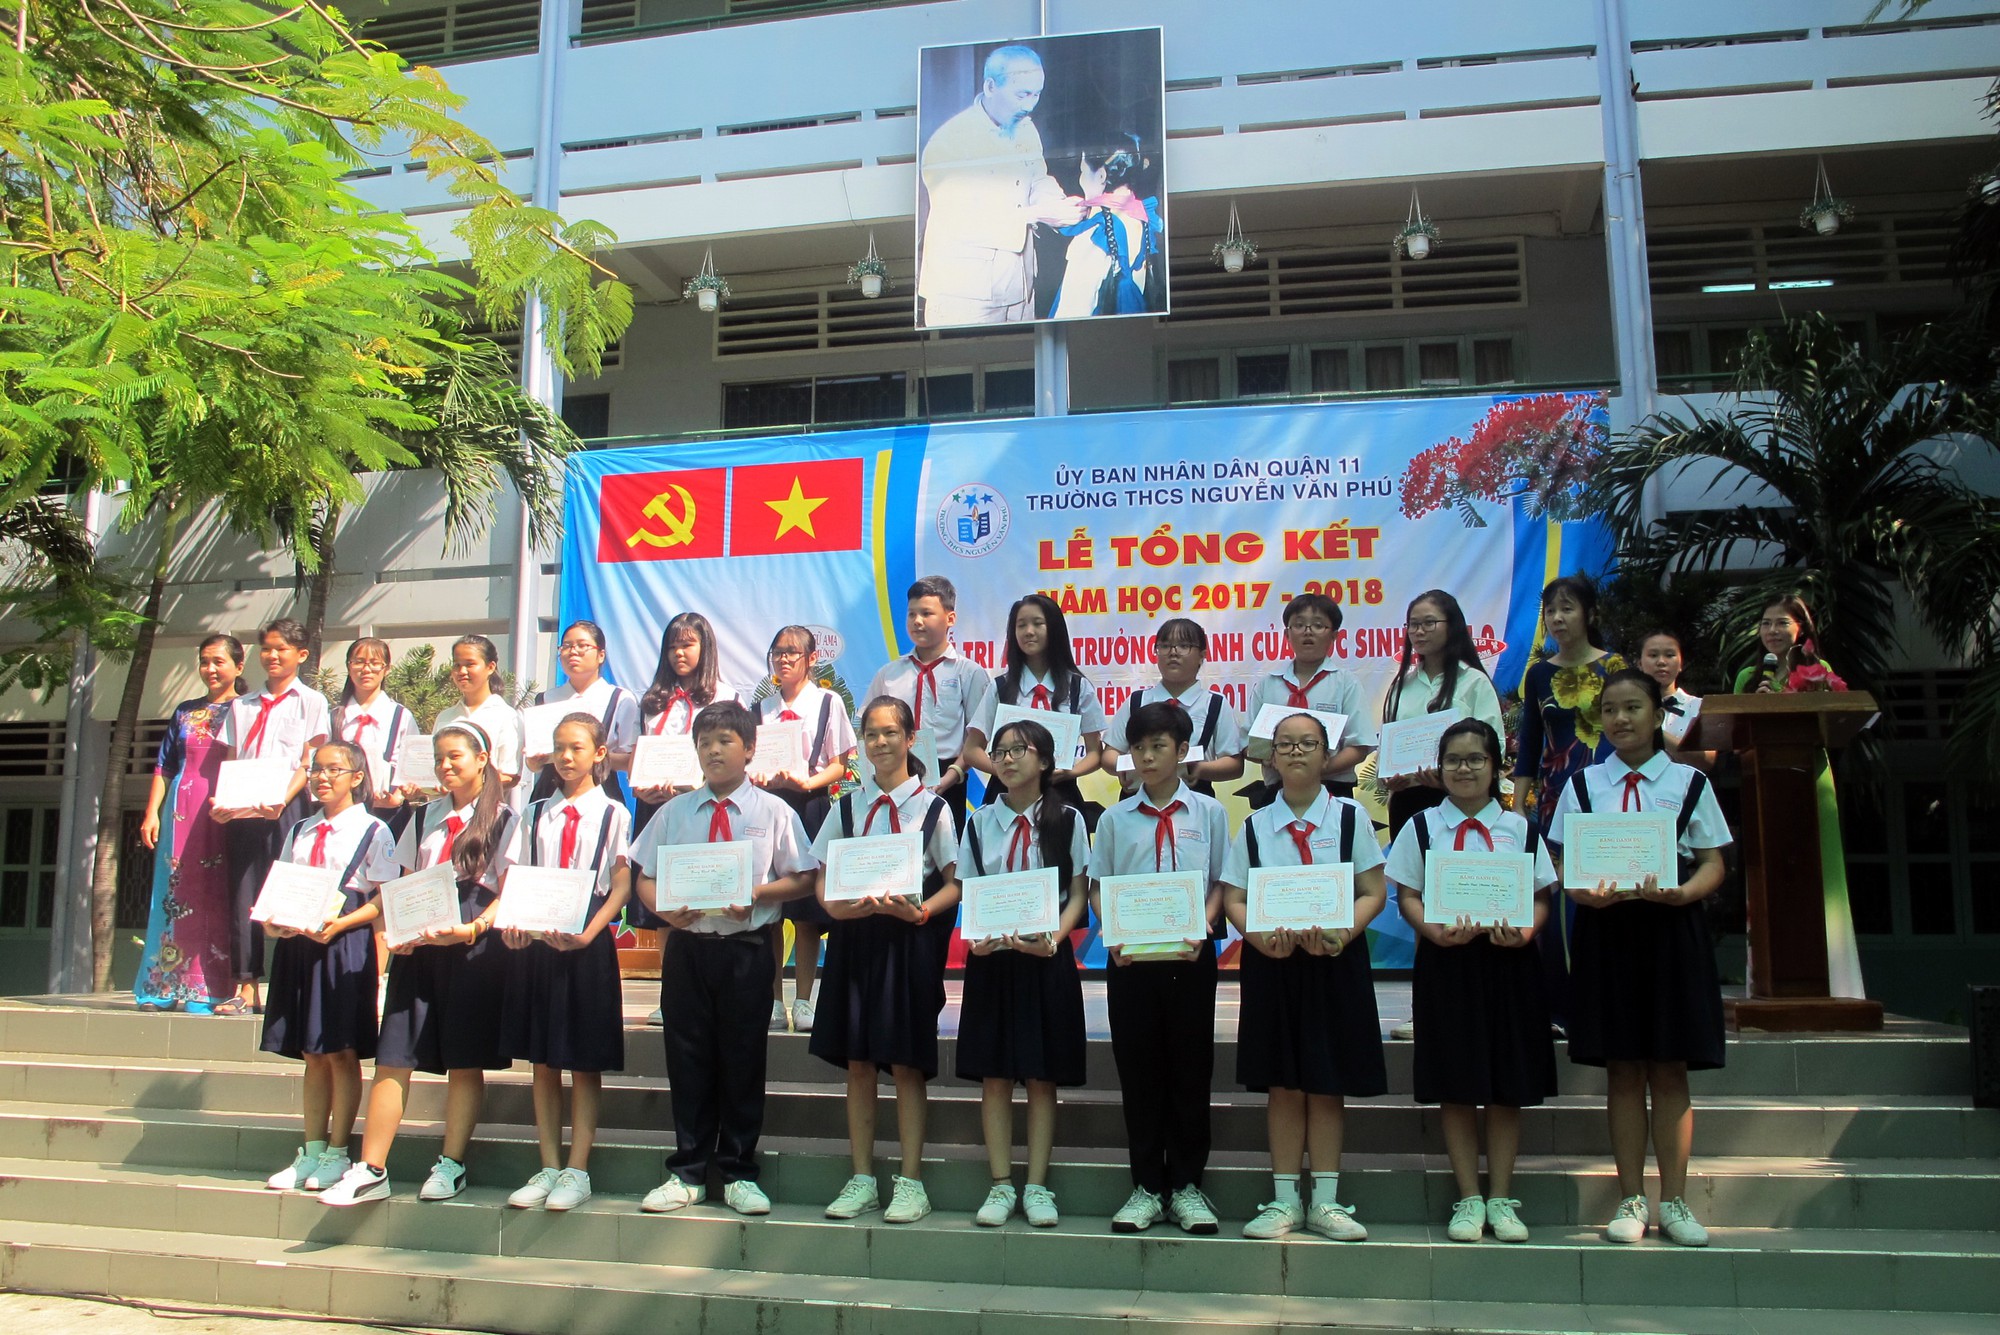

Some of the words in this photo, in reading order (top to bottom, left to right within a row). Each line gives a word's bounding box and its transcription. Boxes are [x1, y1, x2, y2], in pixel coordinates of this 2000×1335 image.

[1056, 464, 1083, 486] ỦY
[1092, 467, 1136, 485] BAN
[1144, 461, 1205, 482] NHÂN
[1214, 459, 1259, 479] DÂN
[1267, 456, 1330, 479] QUẬN
[1339, 458, 1360, 474] 11
[1026, 489, 1117, 511] TRƯỜNG
[1125, 488, 1184, 506] THCS
[1191, 478, 1285, 505] NGUYỄN
[1293, 479, 1338, 499] VĂN
[1346, 476, 1392, 497] PHÚ
[1038, 526, 1094, 571] LỄ
[1109, 522, 1265, 568] TỔNG
[1283, 517, 1380, 562] KẾT
[1117, 584, 1182, 618] HỌC
[1190, 580, 1273, 611] 2017
[963, 640, 994, 669] TRI
[1355, 627, 1408, 659] SINH
